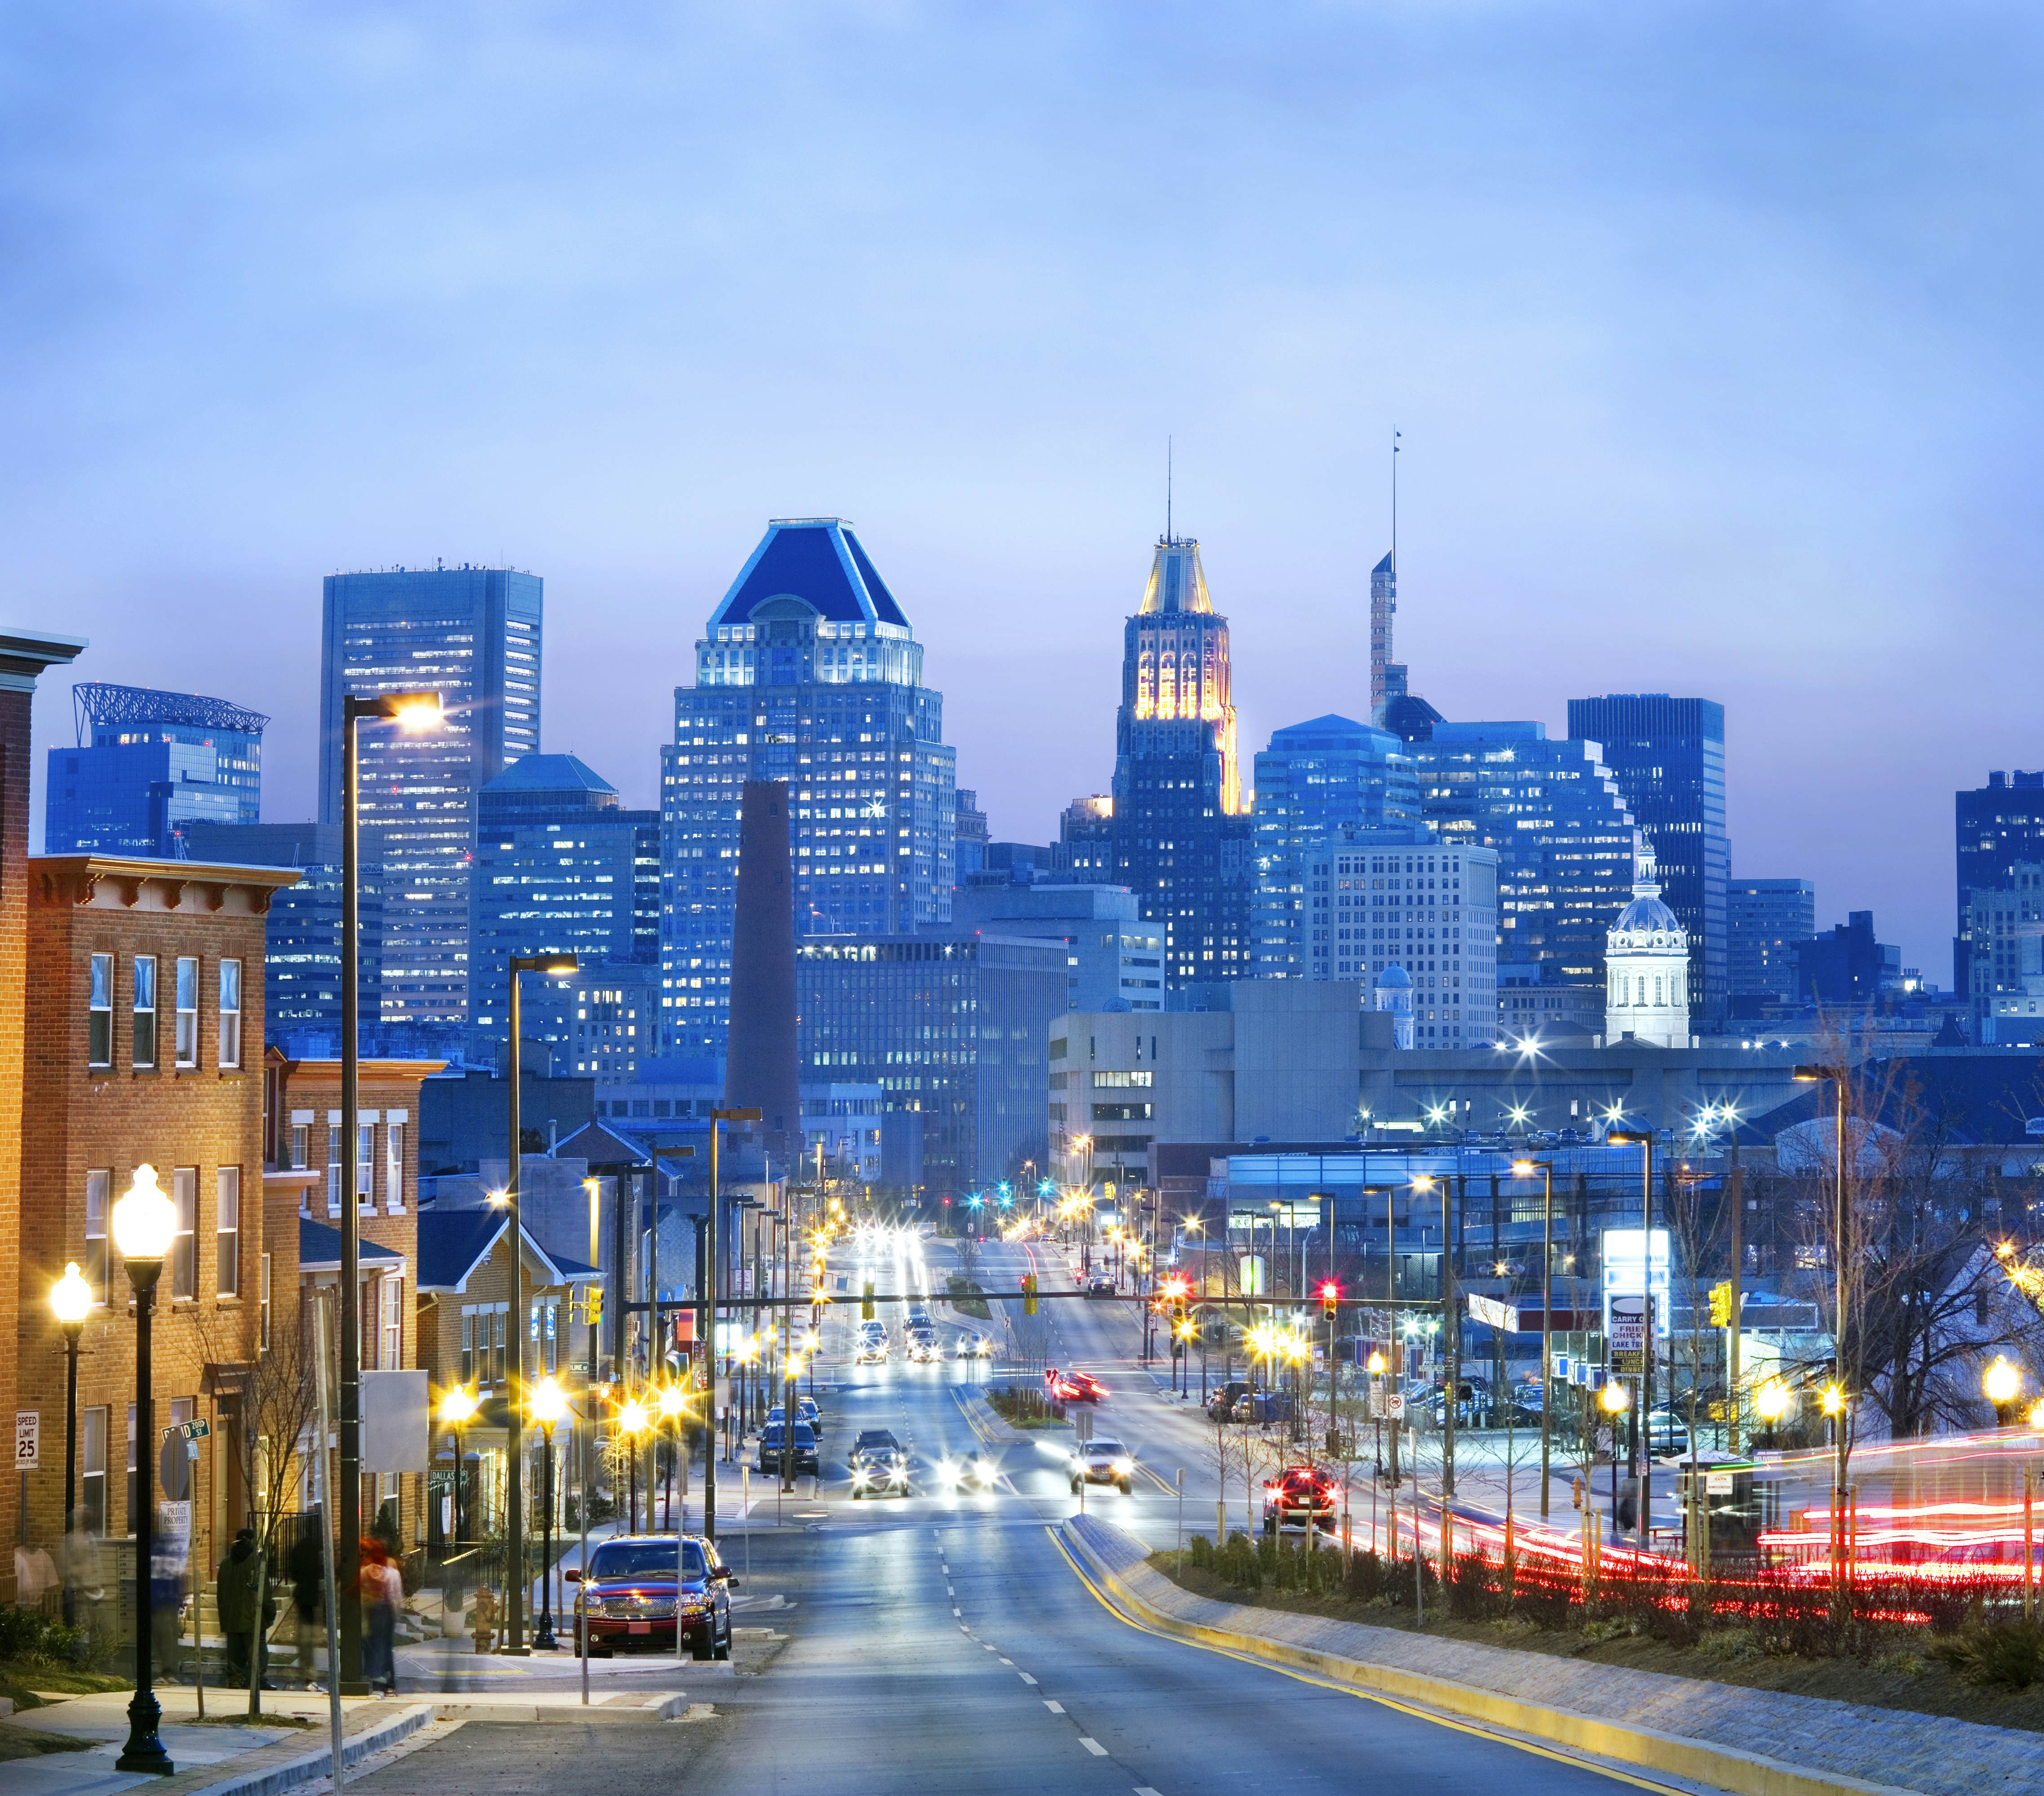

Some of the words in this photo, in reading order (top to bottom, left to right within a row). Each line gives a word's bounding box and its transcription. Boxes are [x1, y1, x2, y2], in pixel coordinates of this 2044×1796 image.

[18, 1416, 36, 1426] SPEED
[191, 1421, 202, 1429] 200
[19, 1429, 34, 1438] LIMIT
[18, 1440, 34, 1458] 25
[432, 1471, 455, 1480] DALLAS
[167, 1507, 186, 1516] PRIVATE
[164, 1516, 188, 1525] PROPERTY
